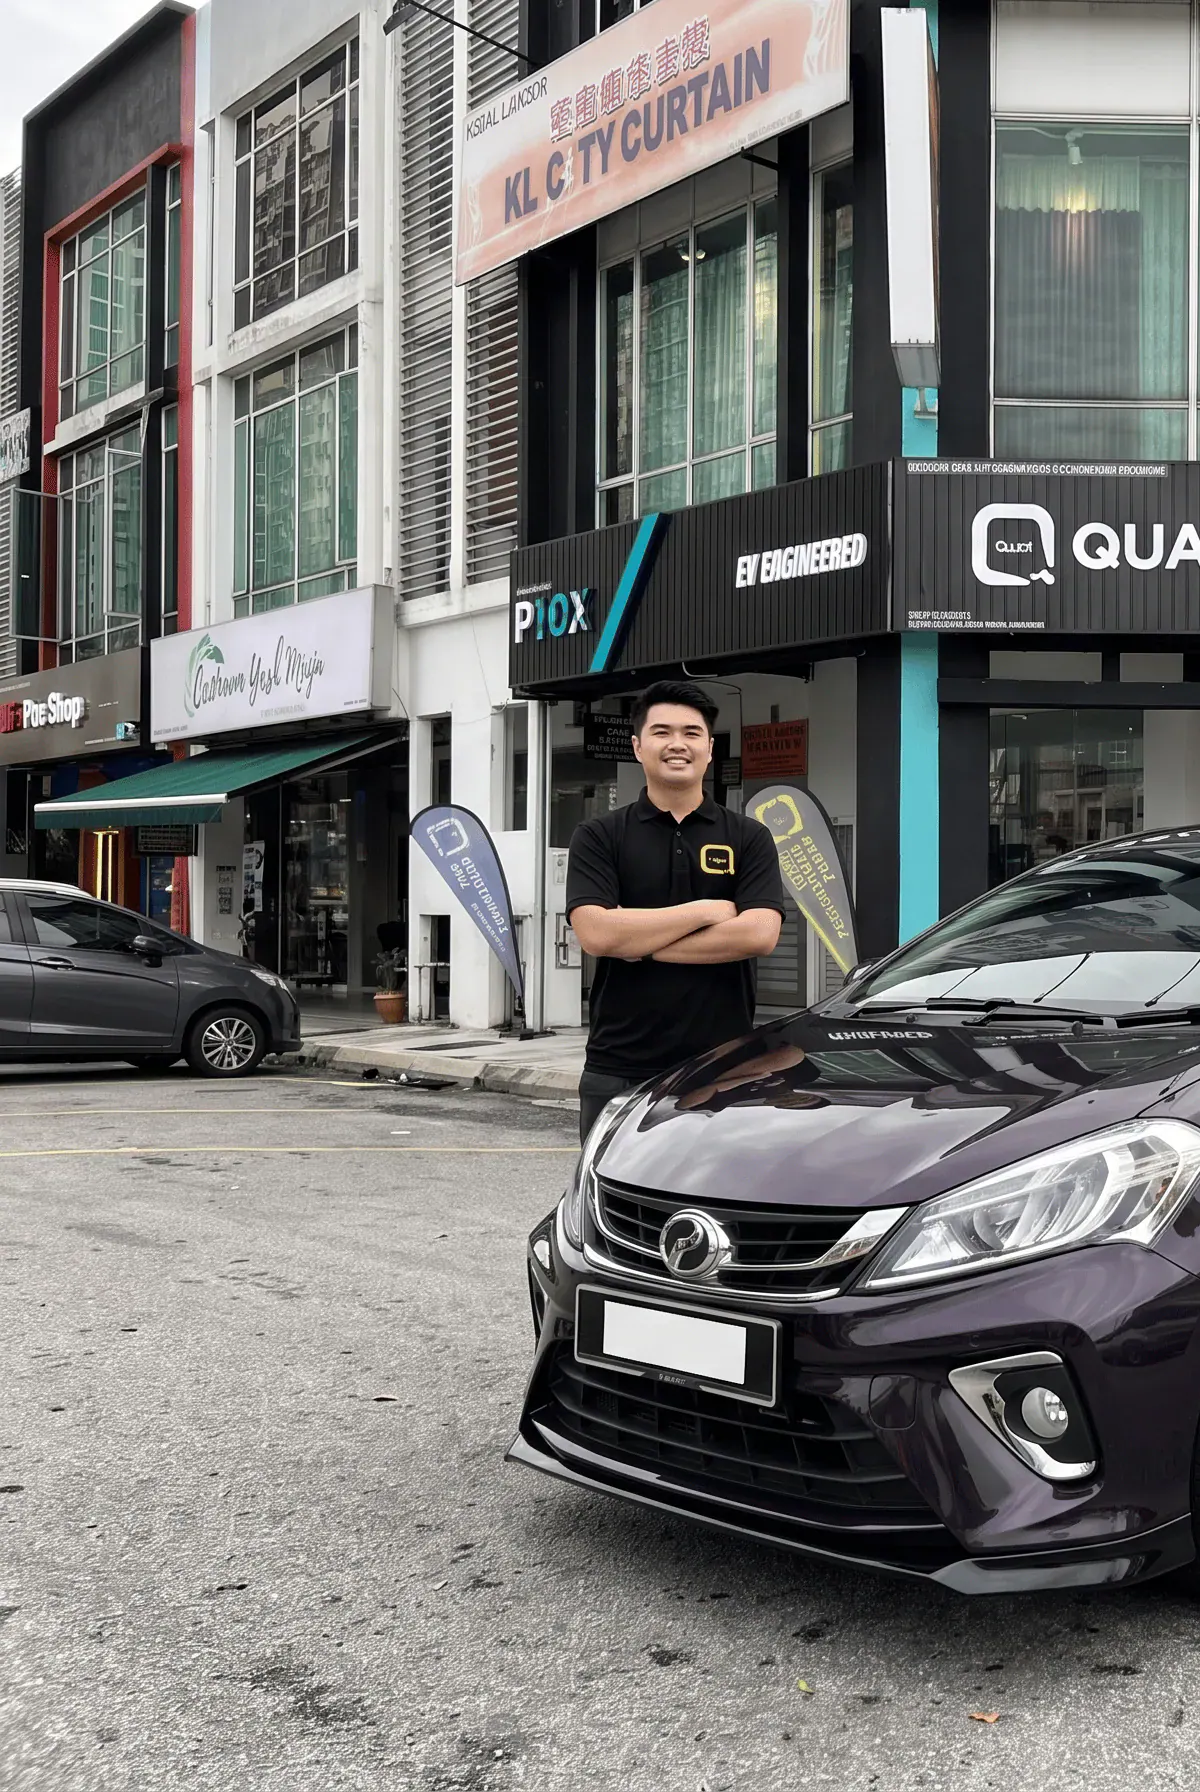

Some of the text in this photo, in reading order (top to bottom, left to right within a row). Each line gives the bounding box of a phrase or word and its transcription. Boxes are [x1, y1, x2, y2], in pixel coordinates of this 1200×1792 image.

[504, 166, 538, 225] KL
[620, 38, 771, 163] CURTAIN
[735, 553, 761, 590] EV
[514, 587, 595, 644] P10X
[47, 691, 85, 729] Shop
